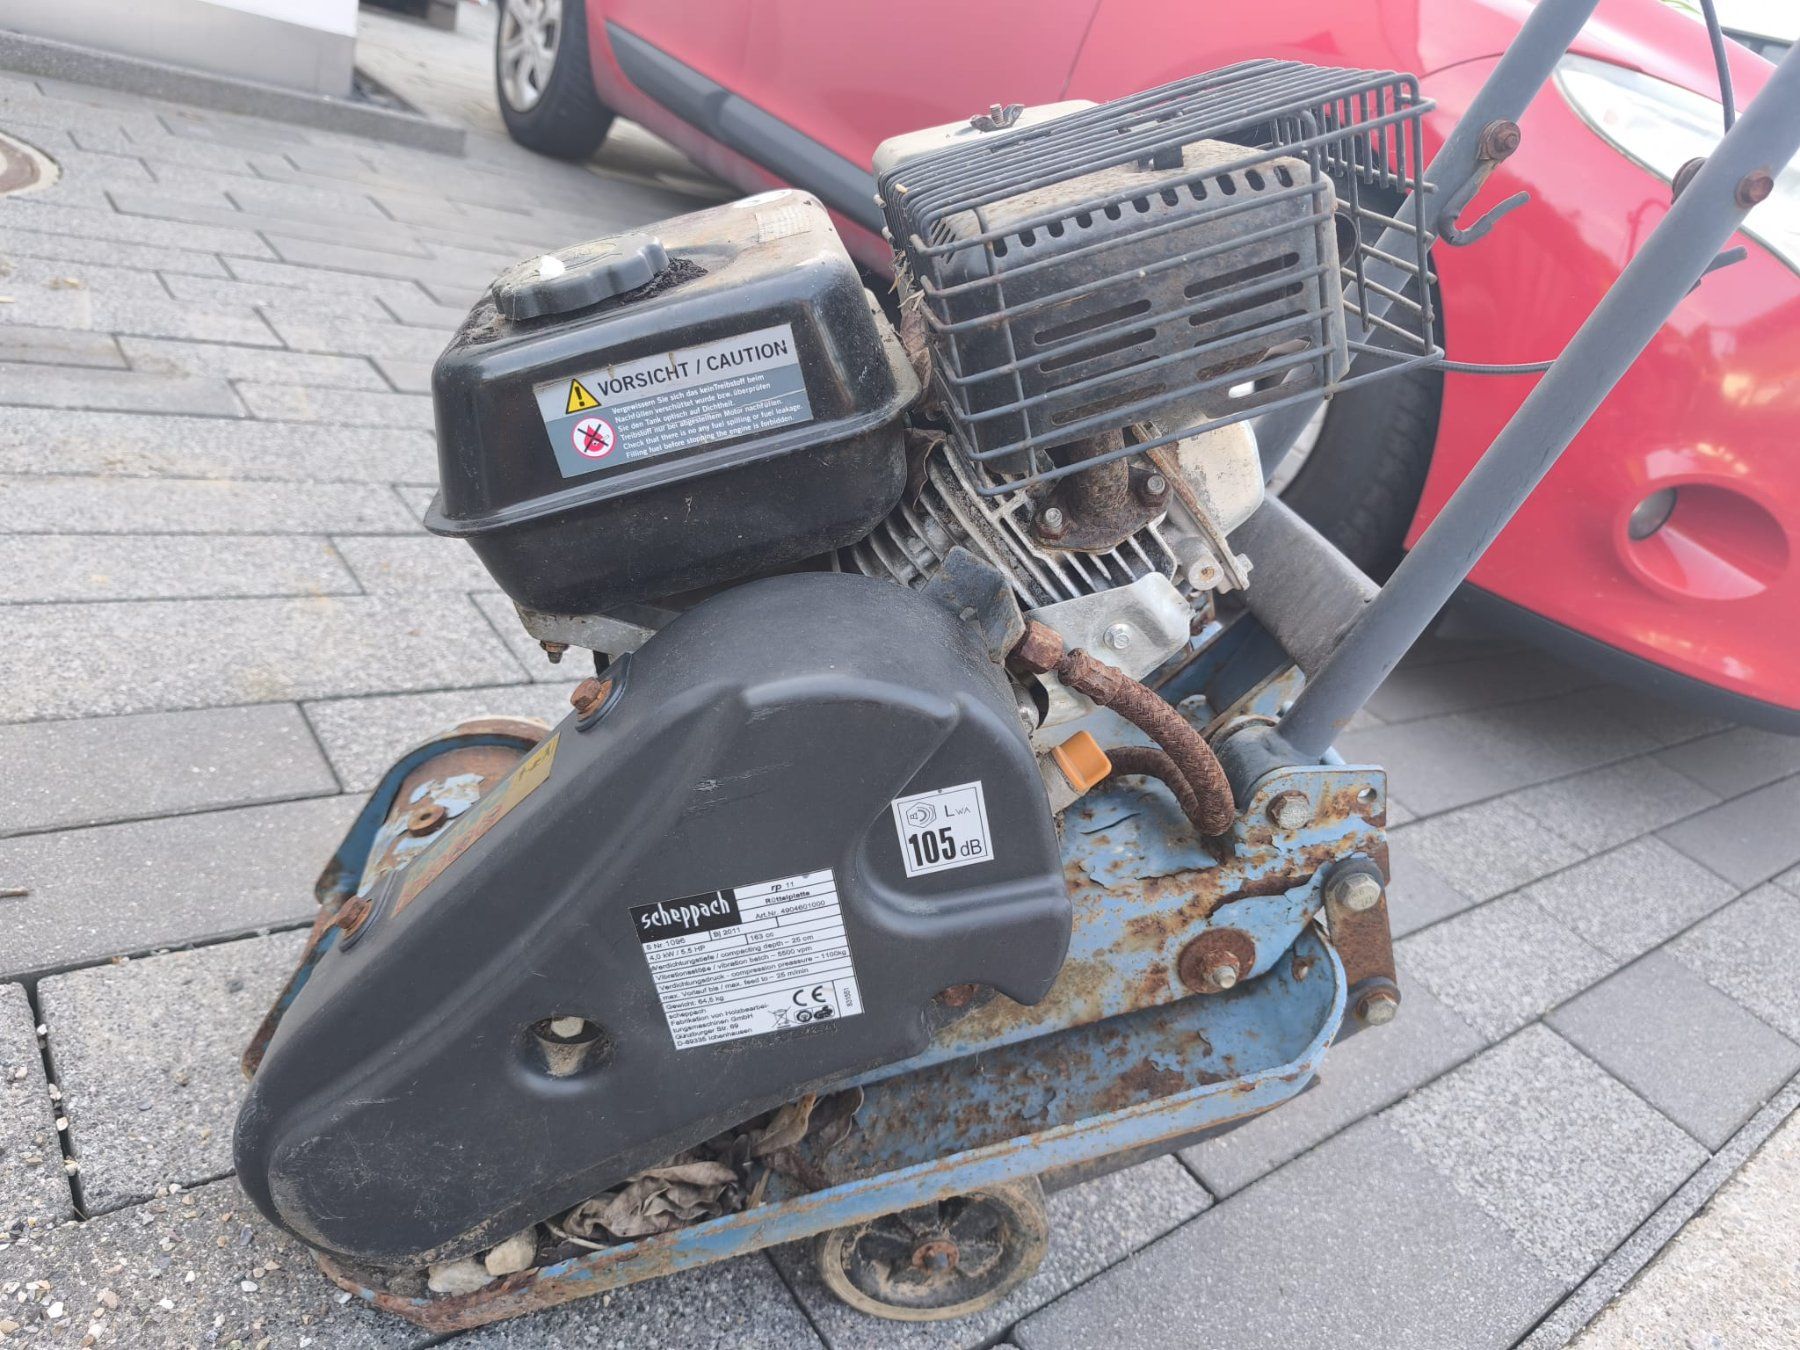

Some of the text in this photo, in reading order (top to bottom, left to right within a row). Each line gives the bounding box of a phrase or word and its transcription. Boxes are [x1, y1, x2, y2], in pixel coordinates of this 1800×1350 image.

[597, 339, 788, 396] VORSICHT / CAUTION
[611, 400, 655, 414] Vergewissern
[656, 396, 668, 404] Sie
[670, 391, 684, 401] sich
[746, 374, 764, 383] beim
[614, 410, 653, 423] Nachfüllen
[655, 399, 693, 414] verschüttet
[694, 395, 715, 404] wurde
[733, 383, 770, 395] überprüfen
[617, 424, 629, 432] Sie
[645, 416, 661, 425] Tank
[662, 410, 688, 421] optisch
[689, 407, 700, 415] auf
[620, 427, 652, 440] Treibstoff
[653, 425, 665, 433] nur
[666, 421, 678, 429] bei
[679, 413, 721, 426] abgestelltem
[723, 408, 743, 416] Motor
[622, 439, 644, 449] Check
[645, 435, 659, 444] that
[660, 432, 679, 441] there
[710, 420, 724, 429] fuel
[726, 416, 751, 426] spilling
[760, 409, 774, 417] fuel
[625, 449, 648, 457] Filling
[648, 444, 662, 452] fuel
[663, 440, 685, 449] before
[729, 425, 751, 434] engine
[760, 416, 793, 427] forbidden.
[908, 826, 982, 867] 105 dB
[770, 884, 782, 892] rp
[641, 890, 731, 928] scheppach
[722, 926, 740, 935] 2011
[750, 933, 763, 941] 163
[662, 950, 675, 958] kW
[720, 946, 761, 957] compacting
[762, 940, 783, 948] depth
[717, 959, 747, 968] vibration
[731, 964, 776, 976] compression
[681, 987, 707, 996] Vorlauf
[743, 977, 759, 985] feed
[793, 985, 827, 1006] CE
[668, 1008, 706, 1019] scheppach
[670, 1015, 709, 1026] Fabrikation
[672, 1013, 753, 1032] tungsmaschinen GmbH
